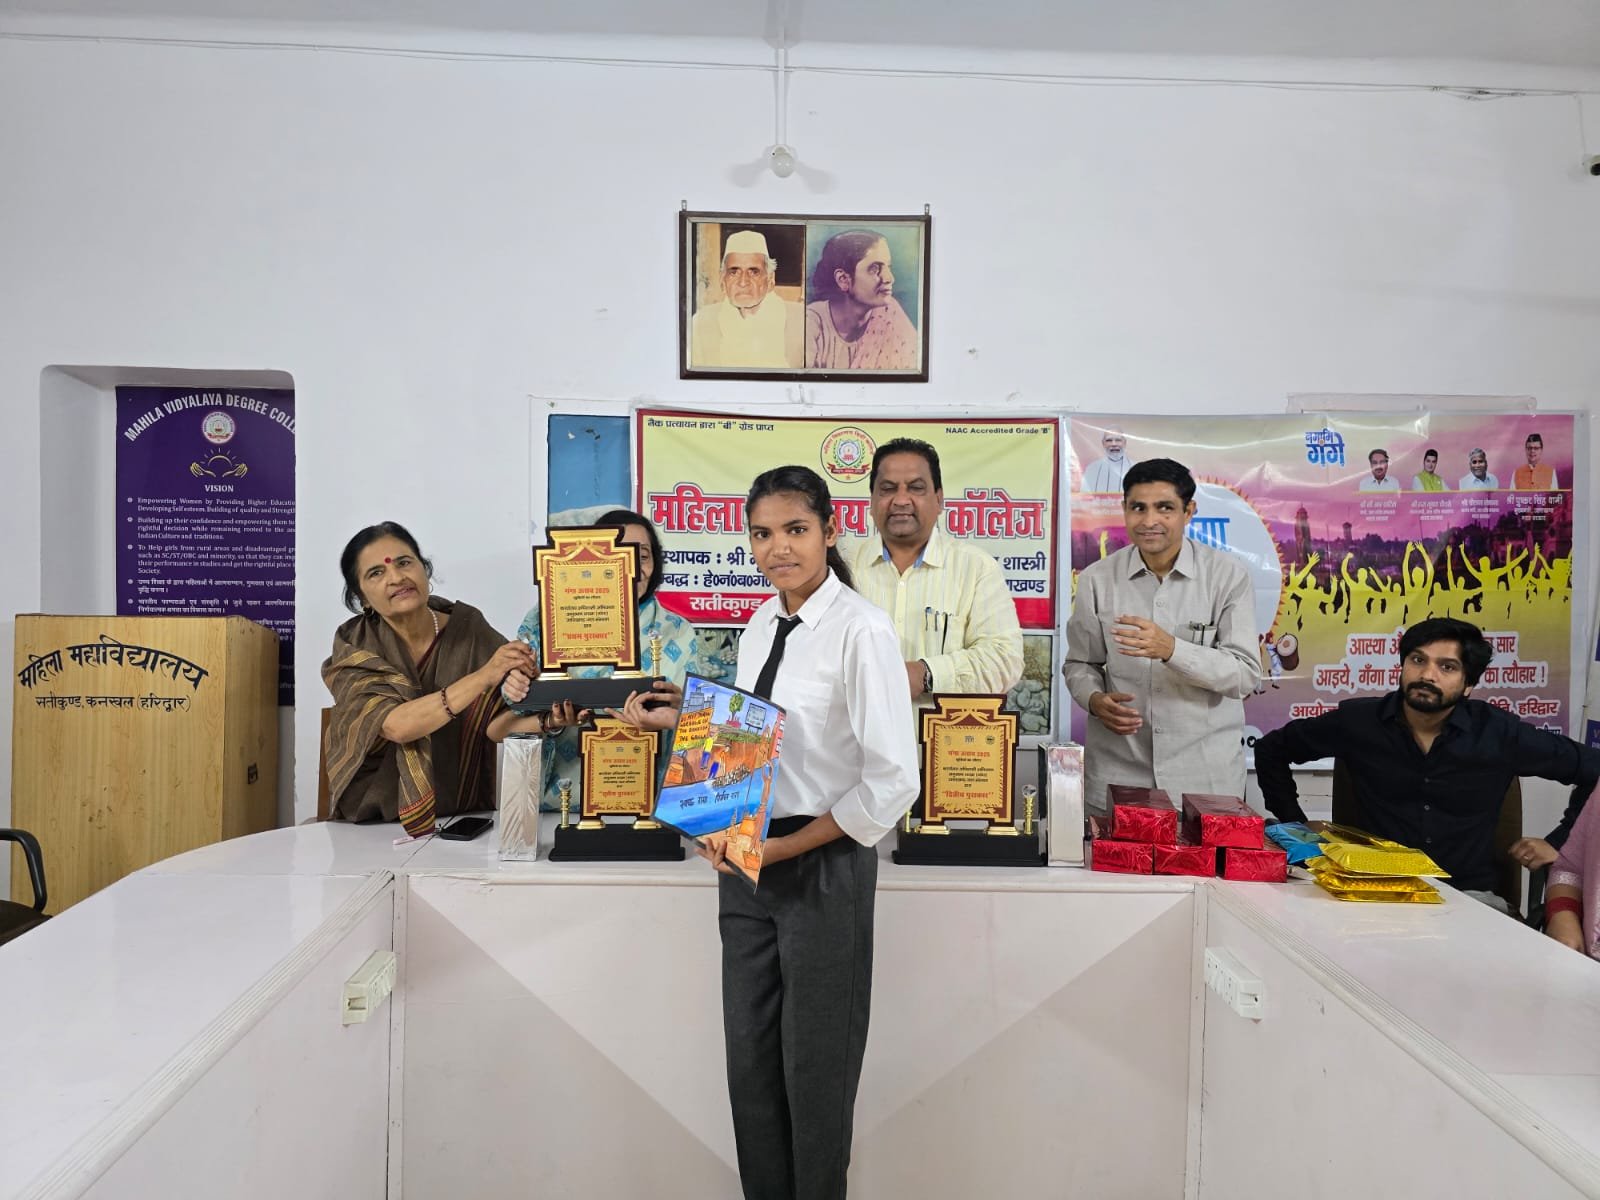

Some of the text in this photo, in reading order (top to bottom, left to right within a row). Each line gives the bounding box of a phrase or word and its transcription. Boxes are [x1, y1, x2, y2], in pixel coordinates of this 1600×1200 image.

[124, 407, 165, 441] MAHILA
[164, 393, 223, 414] VIDYALAYA
[226, 393, 268, 415] DEGREE
[138, 497, 176, 505] Empowering
[138, 505, 172, 513] Developing
[648, 482, 1047, 539] महिला कॉलेज
[211, 525, 241, 533] remaining
[661, 551, 711, 564] स्थापक
[727, 546, 745, 565] श्री
[1003, 551, 1047, 571] शास्त्री
[1006, 579, 1045, 593] ाखण्ड
[1350, 638, 1386, 654] आस्था
[1497, 636, 1516, 653] सार
[18, 634, 209, 692] महिला महाविद्यालय
[1316, 664, 1355, 689] आइये,
[1485, 667, 1499, 683] का
[1502, 660, 1537, 683] त्यौहार
[137, 692, 191, 712] (हरिद्वार)
[1518, 697, 1558, 715] हरिद्वार
